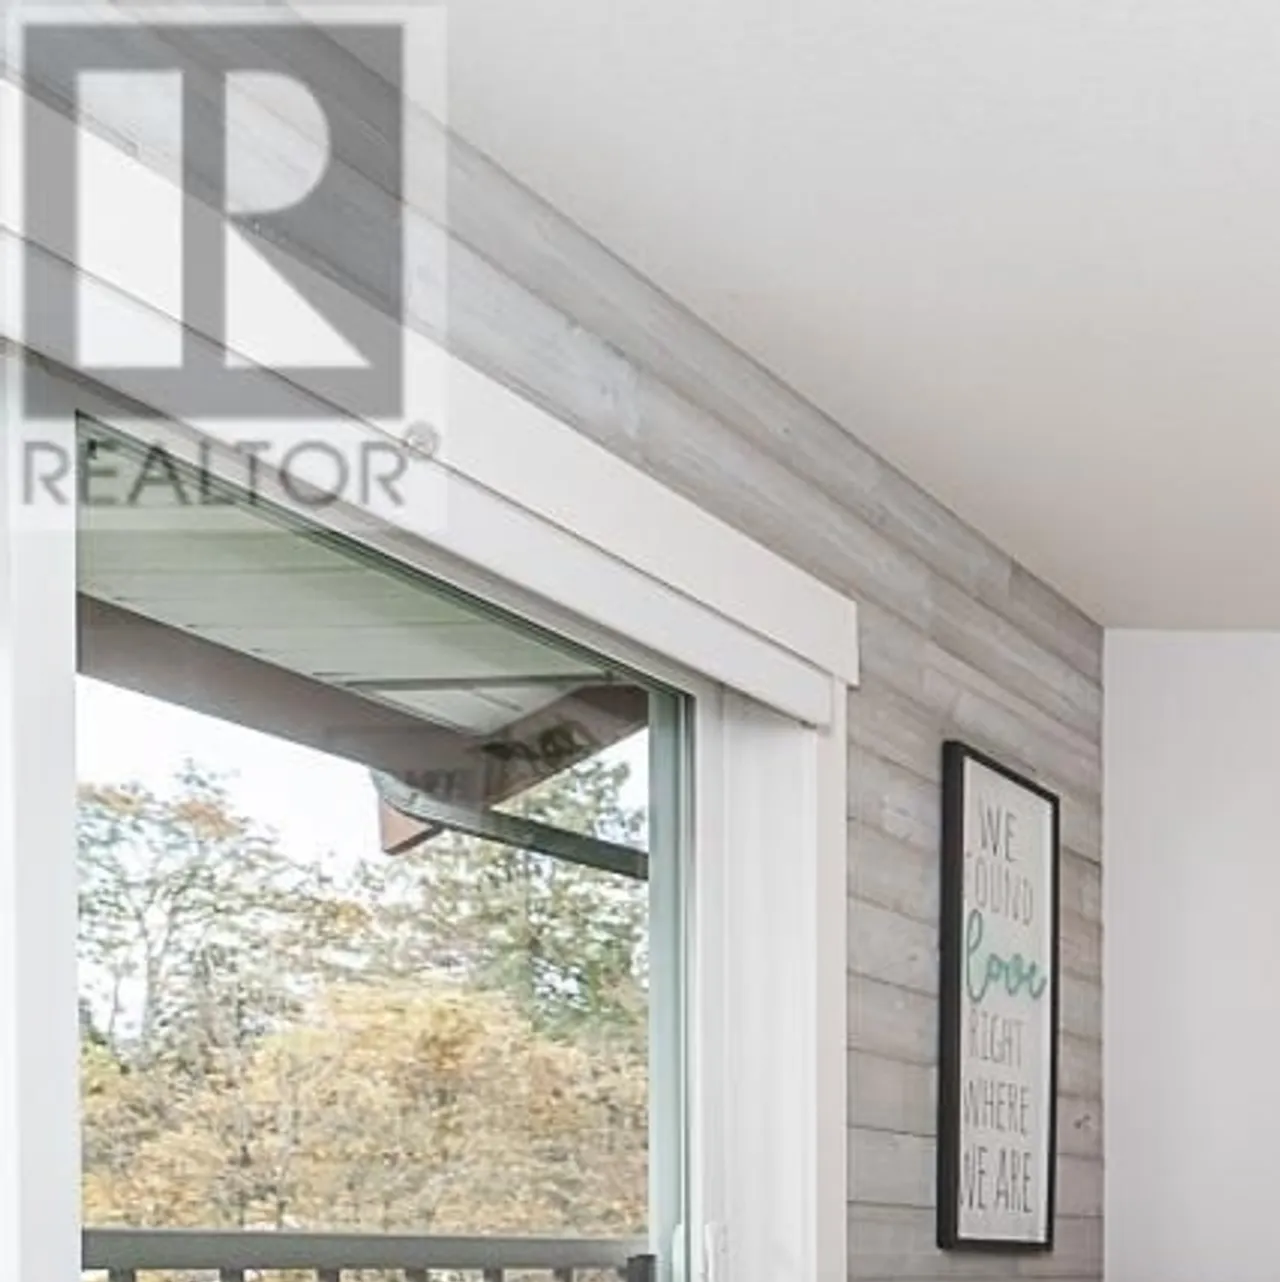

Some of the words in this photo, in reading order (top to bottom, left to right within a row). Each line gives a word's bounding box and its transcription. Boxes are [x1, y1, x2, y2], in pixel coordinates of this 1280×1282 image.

[978, 797, 1017, 862] WE
[967, 908, 1047, 1001] love
[968, 1006, 1024, 1070] RIGHT
[963, 1077, 1028, 1136] WHERE
[994, 1147, 1032, 1214] ARE
